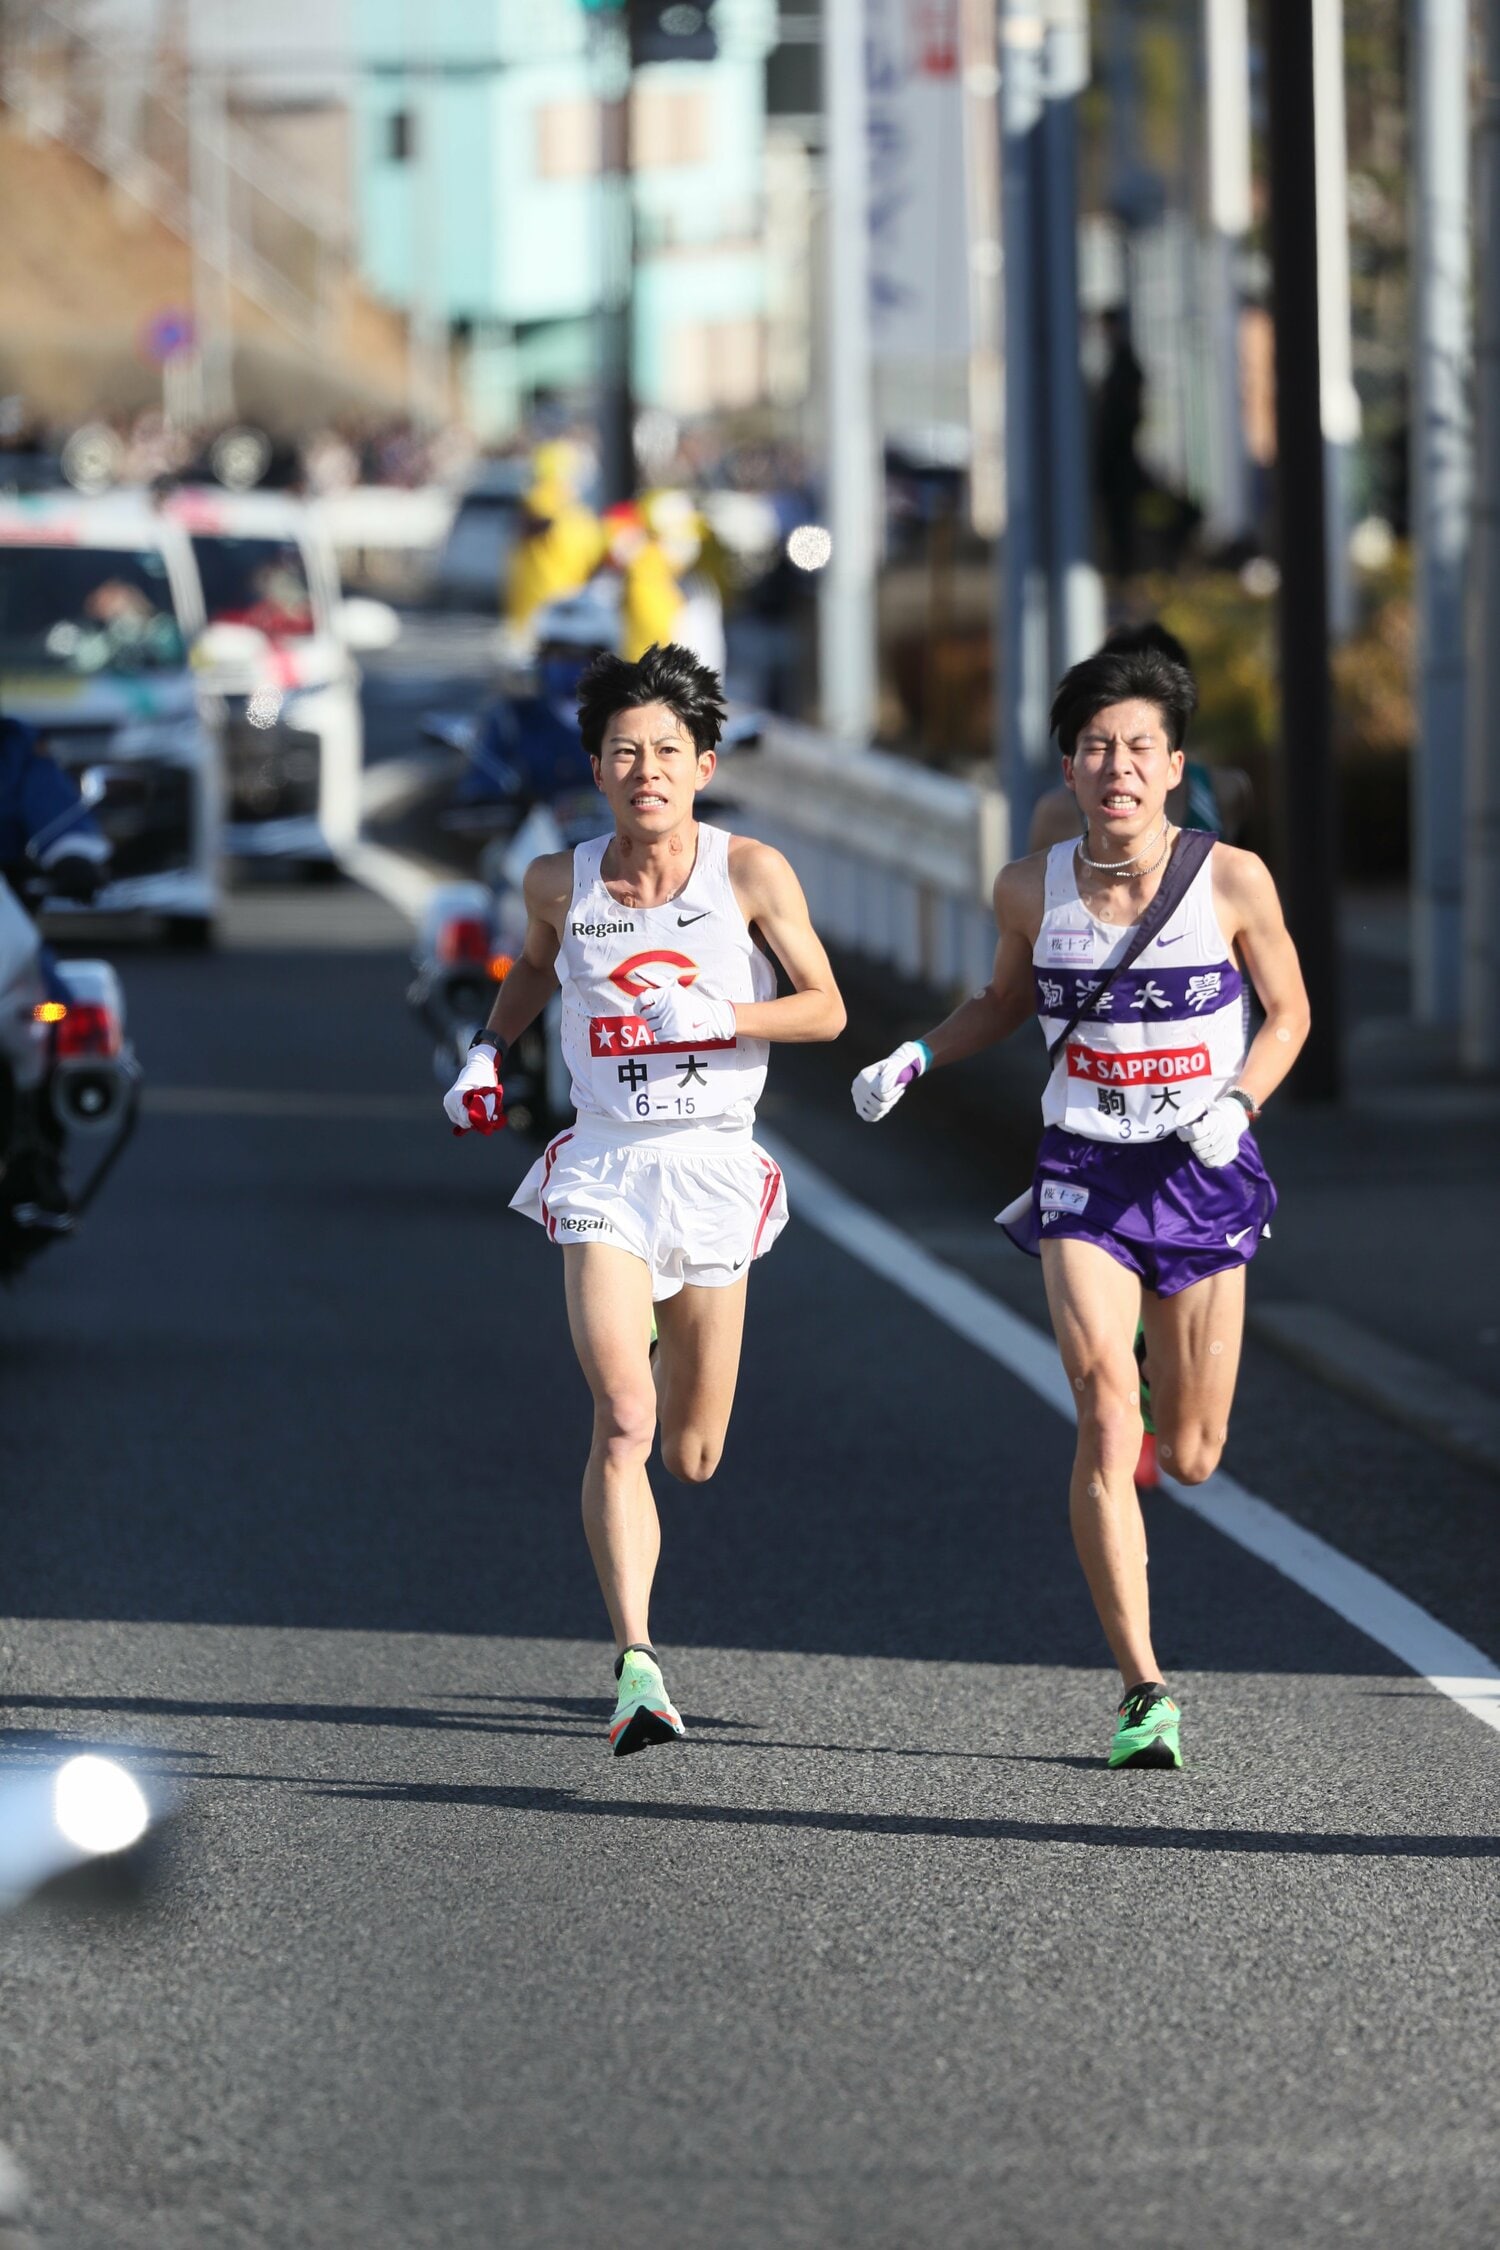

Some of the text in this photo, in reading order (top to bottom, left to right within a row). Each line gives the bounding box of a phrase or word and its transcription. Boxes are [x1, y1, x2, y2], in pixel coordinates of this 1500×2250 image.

[572, 920, 634, 937] Regain
[1096, 1053, 1206, 1080] SAPPORO
[636, 1094, 695, 1116] 6-15
[560, 1217, 613, 1233] Regain
